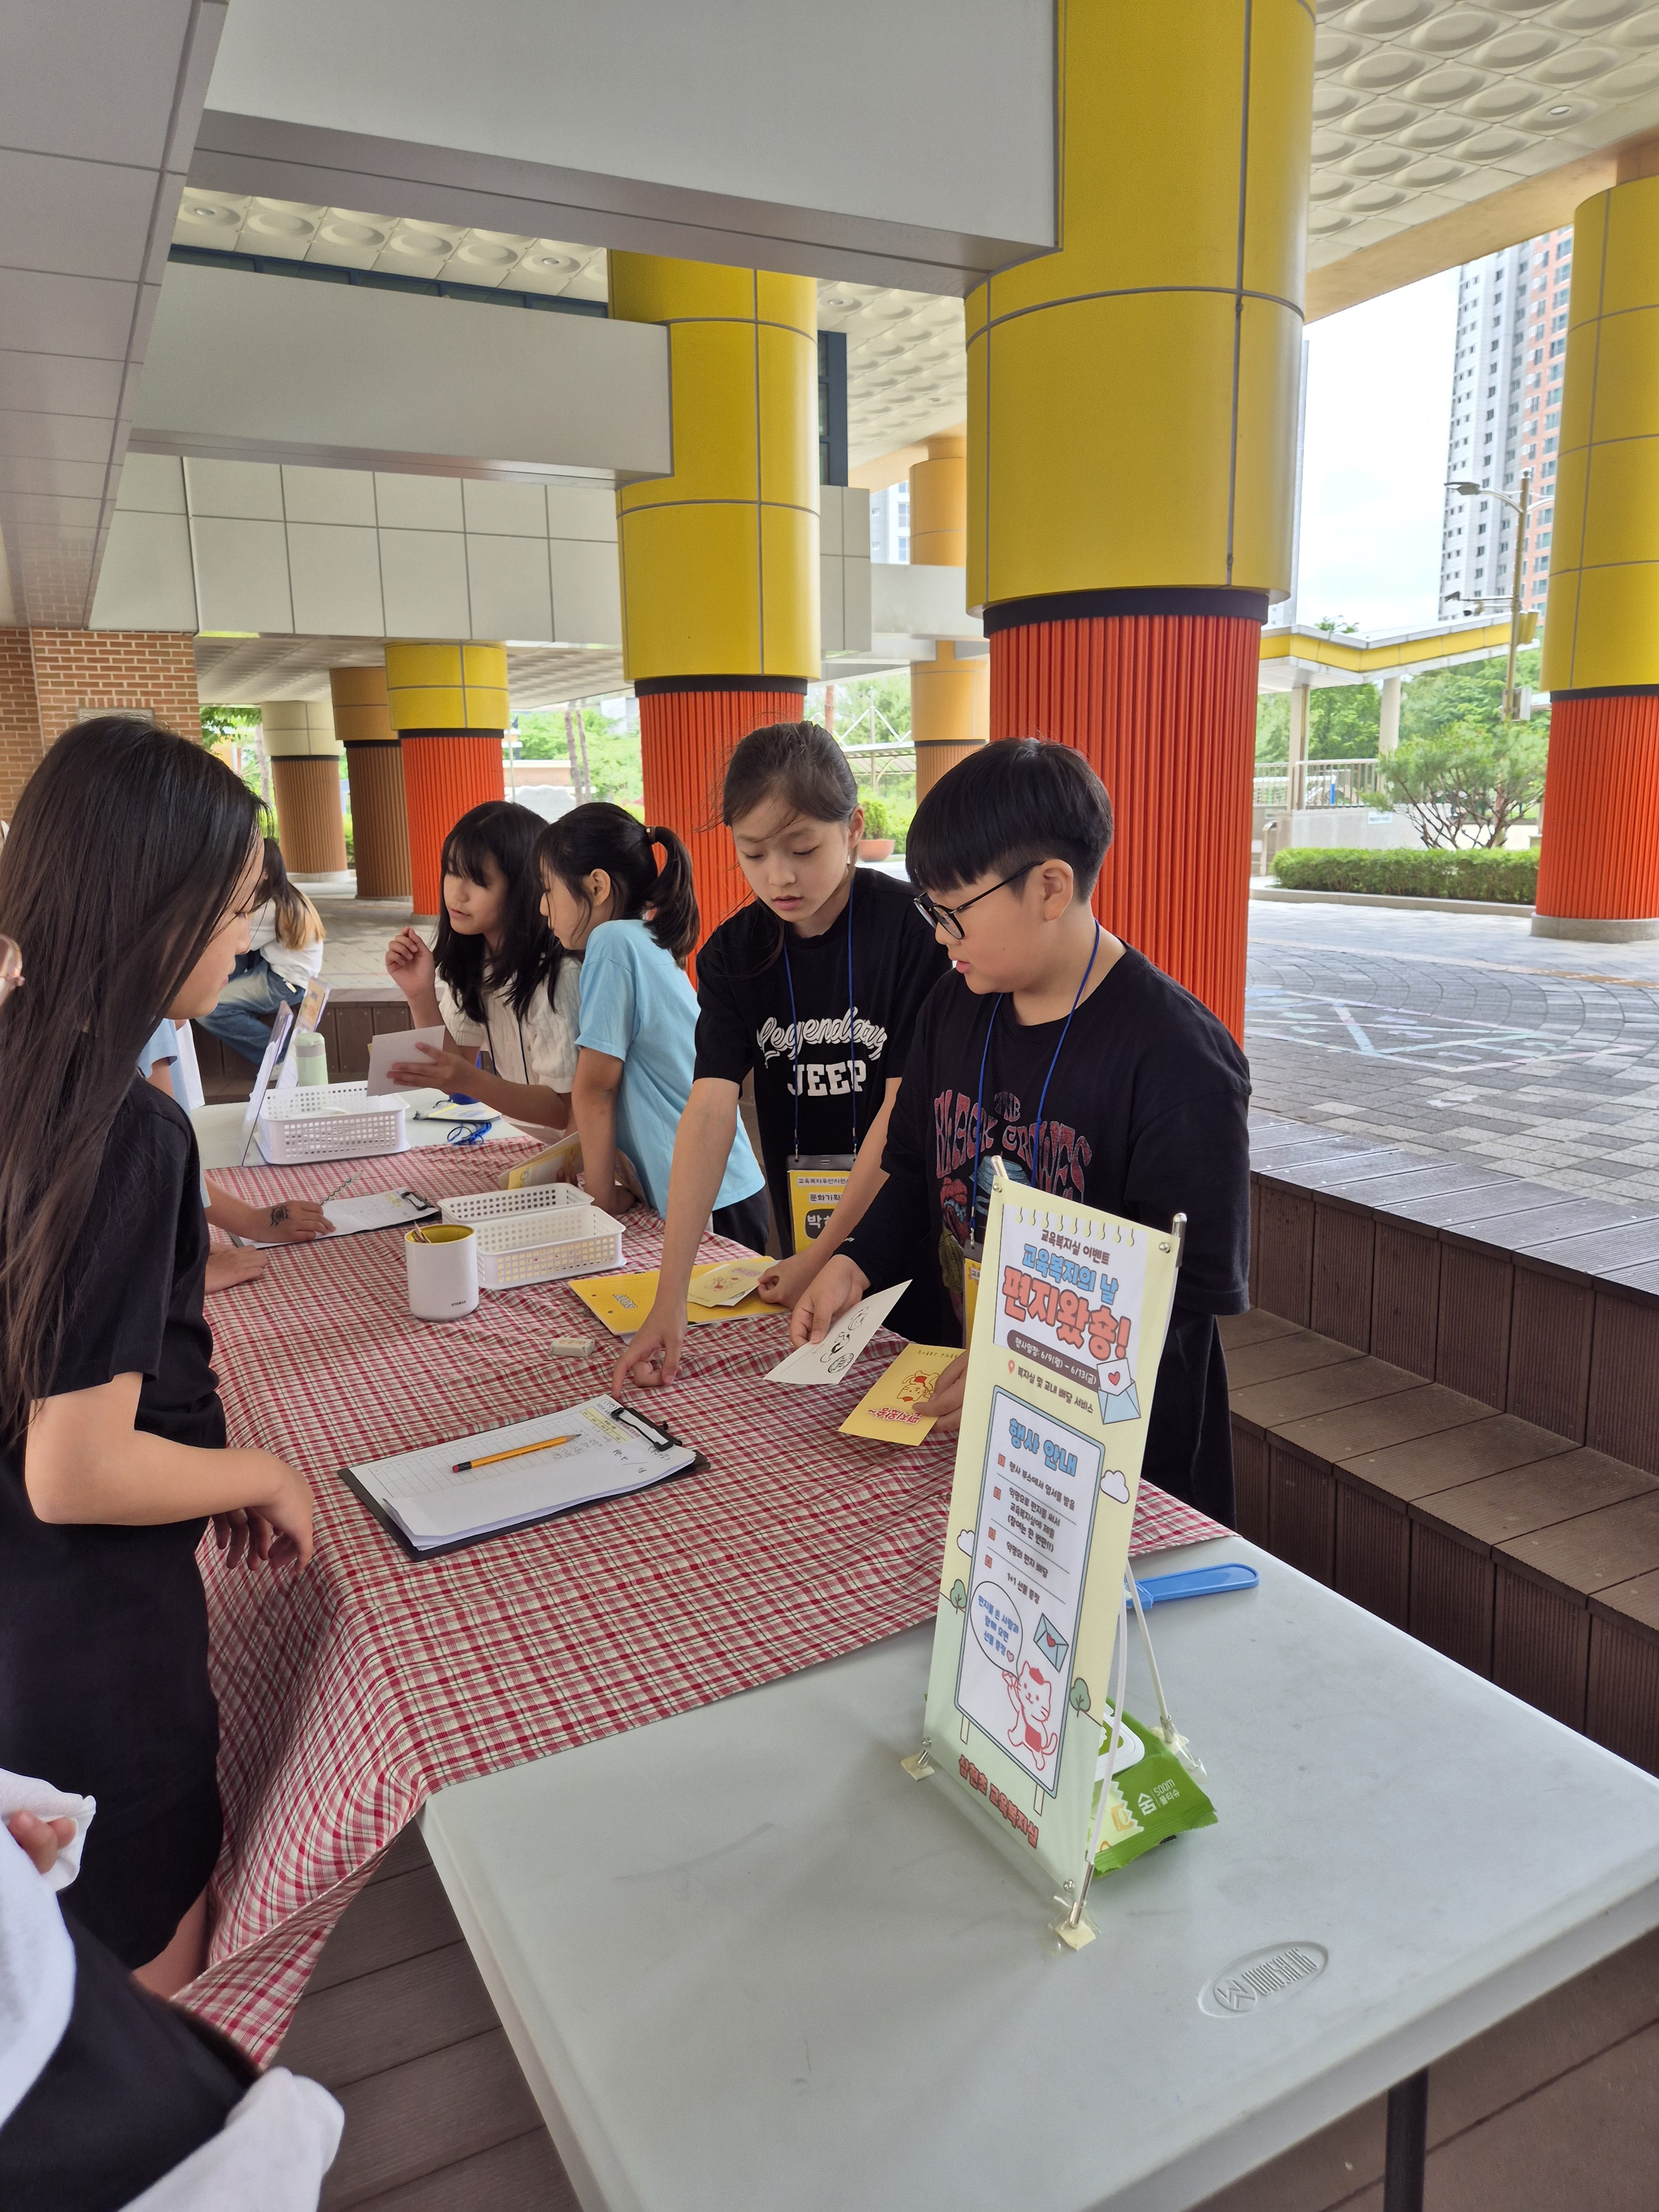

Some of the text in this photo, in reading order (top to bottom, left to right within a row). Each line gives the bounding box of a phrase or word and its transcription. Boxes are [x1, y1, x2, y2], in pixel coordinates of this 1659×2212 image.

[757, 1006, 888, 1069] Legendary
[787, 1060, 866, 1096] JEEP
[935, 1089, 998, 1178] BLACK
[1041, 1229, 1110, 1265] 교육복지실 이벤트
[1022, 1243, 1119, 1306] 교육복지의 날
[1002, 1265, 1131, 1361] 편지왔송!
[1015, 1337, 1040, 1357] 행사일정:
[1041, 1351, 1063, 1368] 6/9(월)
[1071, 1366, 1097, 1385] 6/13(금)
[1018, 1366, 1093, 1414] 복지실 및 교내 배달 서비스
[1009, 1418, 1078, 1477] 행사 안내
[1009, 1461, 1075, 1511] 행사 부스에서 엽서를 받음
[1009, 1486, 1060, 1526] 익명으로 편지를 써서
[1010, 1502, 1055, 1540] 교육복지실에 제출
[1008, 1514, 1054, 1553] (참여는 한 번만!!)
[1006, 1541, 1048, 1579] 익명의 편지 배달
[1007, 1573, 1040, 1604] 1+1 선물 증정
[978, 1595, 1019, 1634] 편지를 쓴 사람과
[984, 1615, 1009, 1643] 함께 오면
[984, 1630, 1006, 1656] 선물 증정
[989, 1782, 1039, 1849] 교육복지실
[1159, 1789, 1180, 1806] 물티슈
